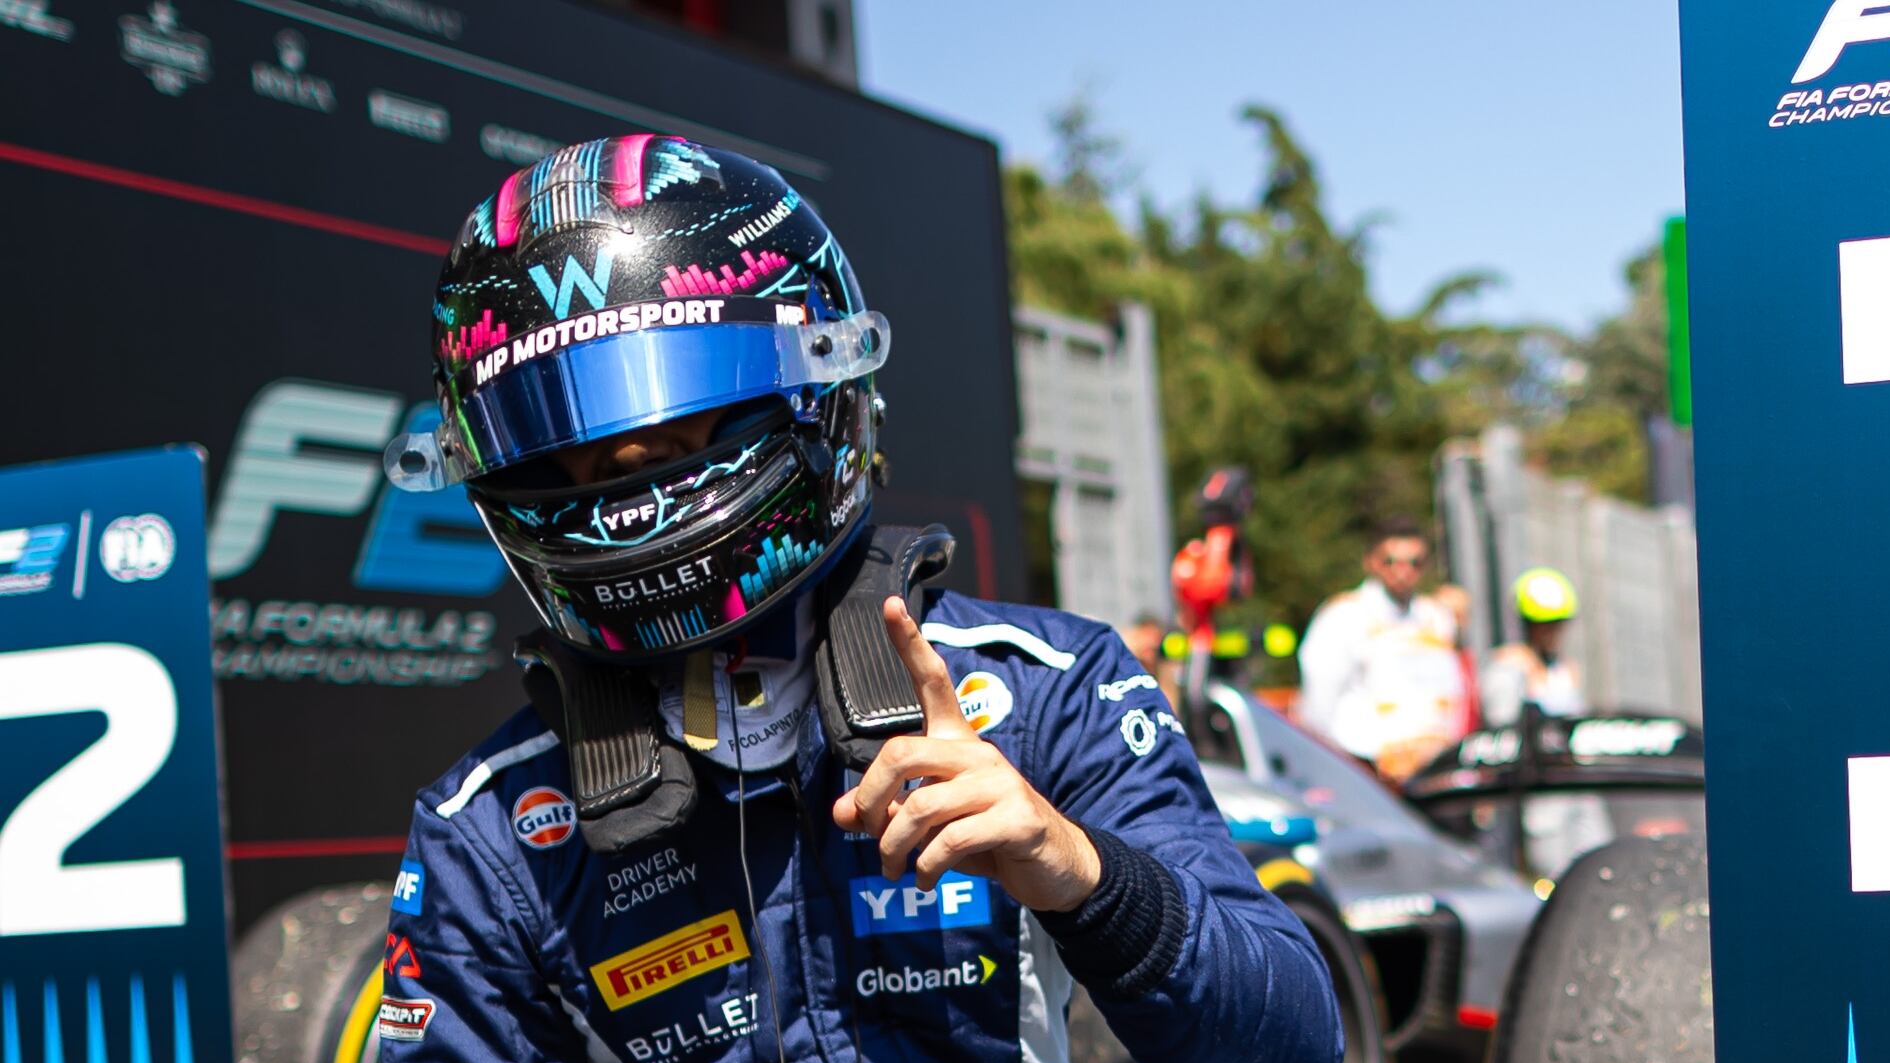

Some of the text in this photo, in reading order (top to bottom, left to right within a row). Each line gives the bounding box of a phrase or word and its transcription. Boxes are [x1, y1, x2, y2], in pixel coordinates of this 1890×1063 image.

[1776, 89, 1824, 111] FIA
[728, 200, 792, 248] WILLIAMS
[476, 299, 725, 387] MP MOTORSPORT
[602, 503, 656, 531] YPF
[740, 708, 801, 749] COLAPINTO
[0, 642, 187, 937] 2
[515, 804, 577, 836] Gulf
[603, 863, 697, 918] ACADEMY
[607, 848, 679, 892] DRIVER
[859, 880, 974, 920] YPF
[606, 923, 735, 998] PIRELLI
[857, 960, 978, 997] Globant
